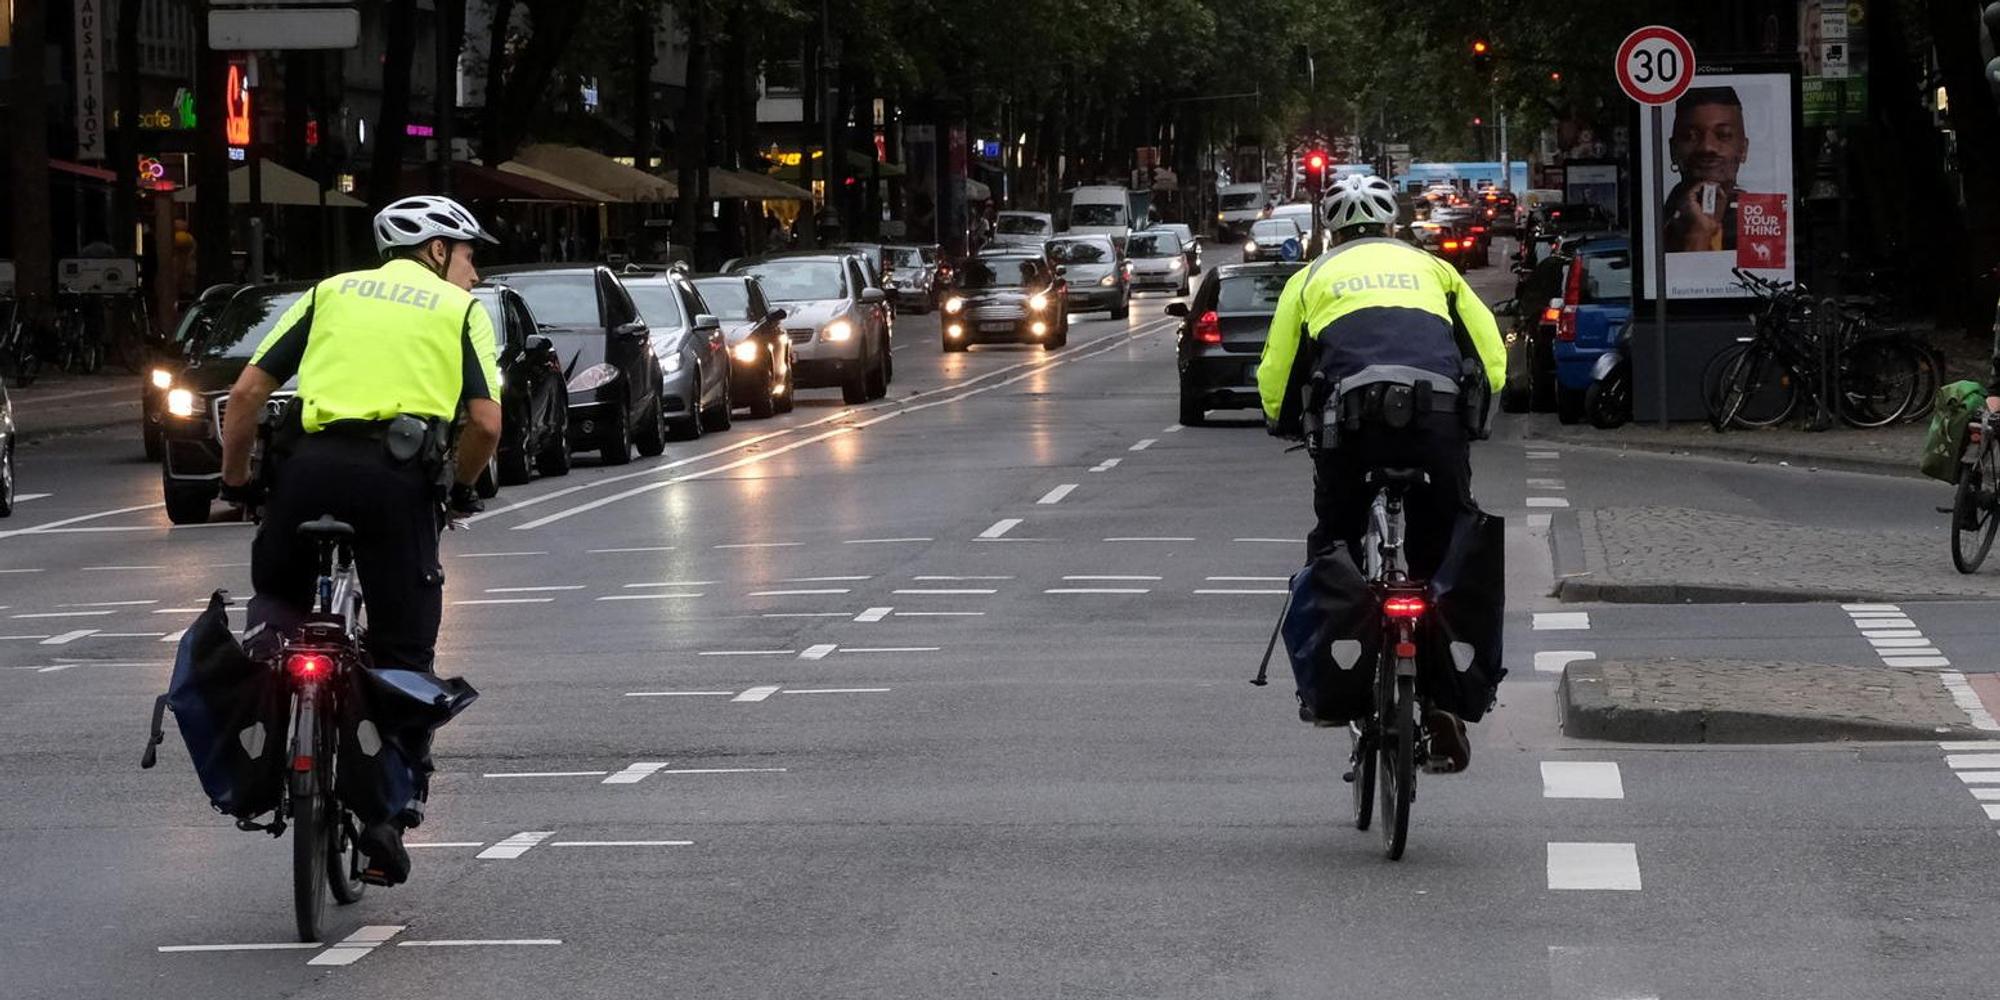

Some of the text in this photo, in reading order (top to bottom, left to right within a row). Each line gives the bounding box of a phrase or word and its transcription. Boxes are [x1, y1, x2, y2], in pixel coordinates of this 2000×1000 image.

[1634, 48, 1677, 83] 30
[1744, 205, 1763, 214] DO
[1744, 215, 1778, 225] YOUR
[1744, 225, 1781, 236] THING
[339, 278, 440, 311] POLIZEI
[1332, 273, 1420, 298] POLIZEI
